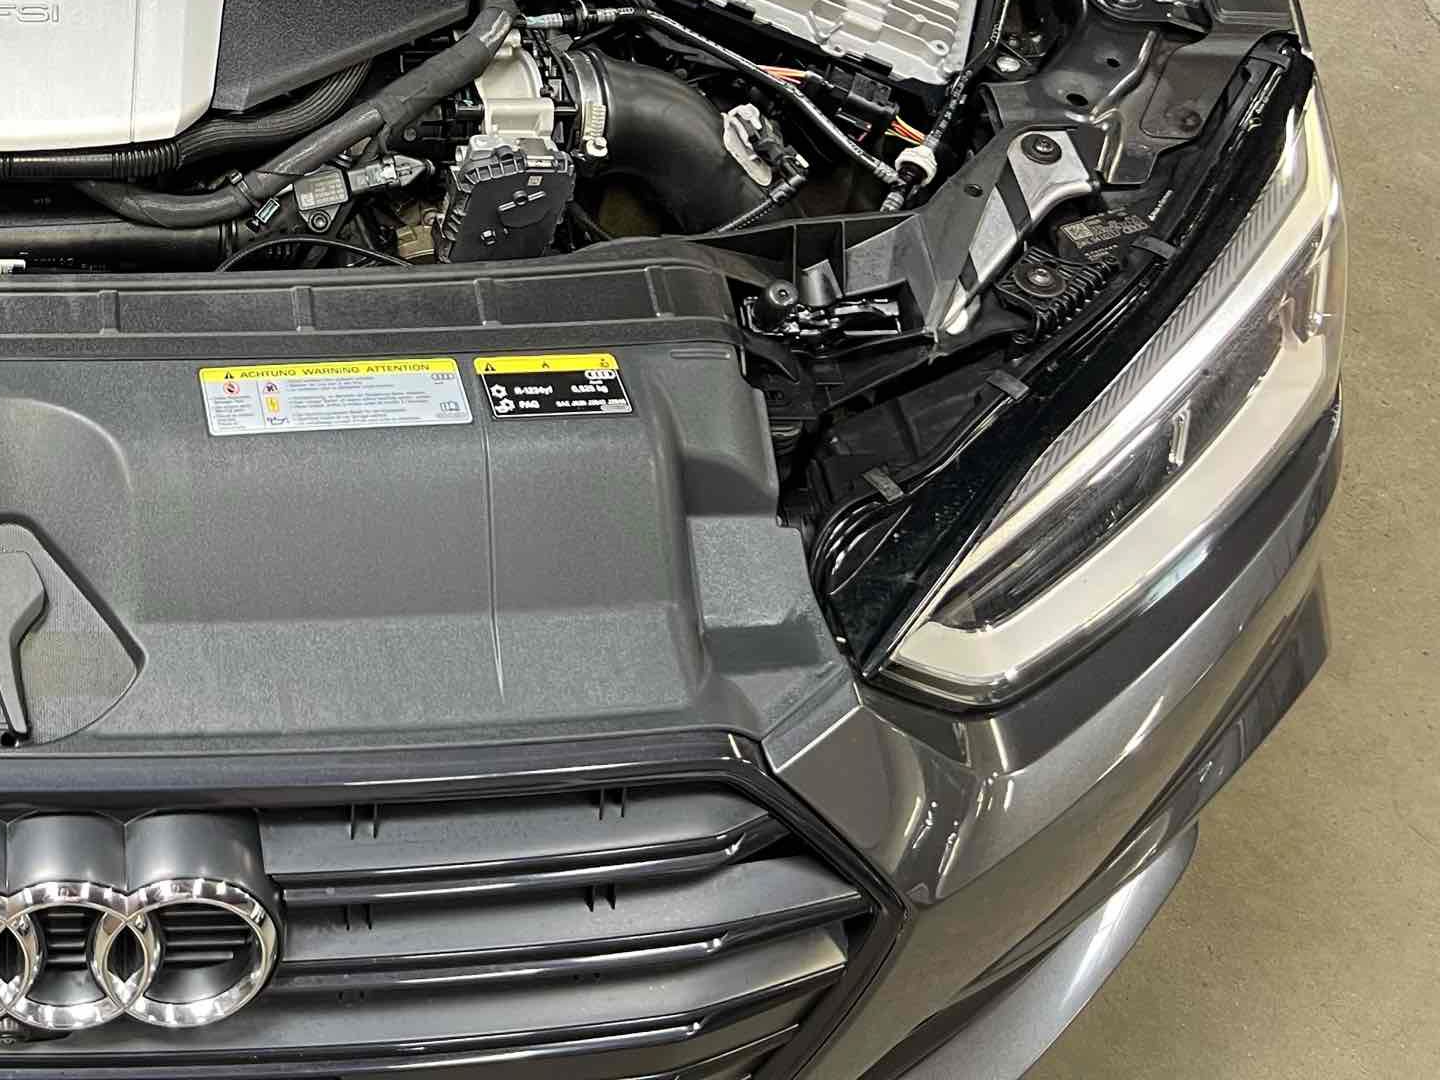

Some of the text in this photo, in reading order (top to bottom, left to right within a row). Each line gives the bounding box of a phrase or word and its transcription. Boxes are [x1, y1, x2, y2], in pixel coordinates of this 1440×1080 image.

[240, 364, 430, 379] ACHTUNG WARNING ATTENTION
